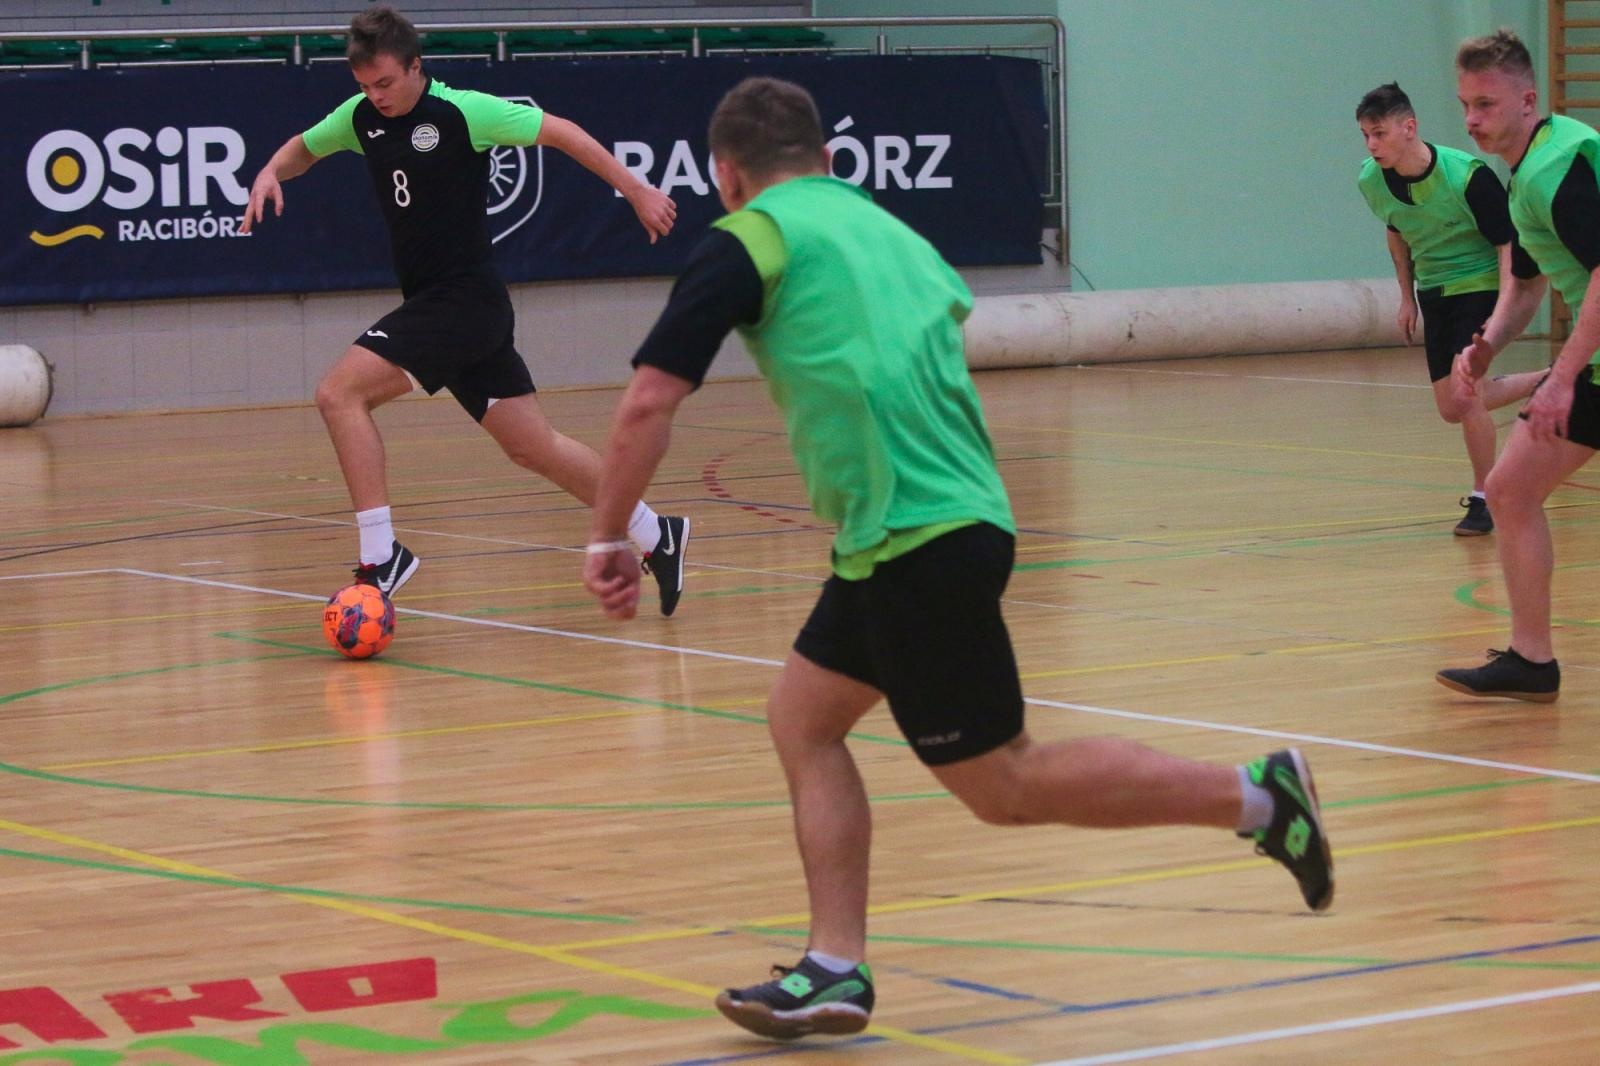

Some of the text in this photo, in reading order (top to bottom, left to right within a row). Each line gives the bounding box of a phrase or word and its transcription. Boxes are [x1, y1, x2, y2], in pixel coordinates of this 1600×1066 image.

[26, 126, 250, 212] OSiR
[613, 115, 953, 198] RAÓRZ
[392, 169, 411, 207] 8
[118, 210, 253, 242] RACIBÓRZ
